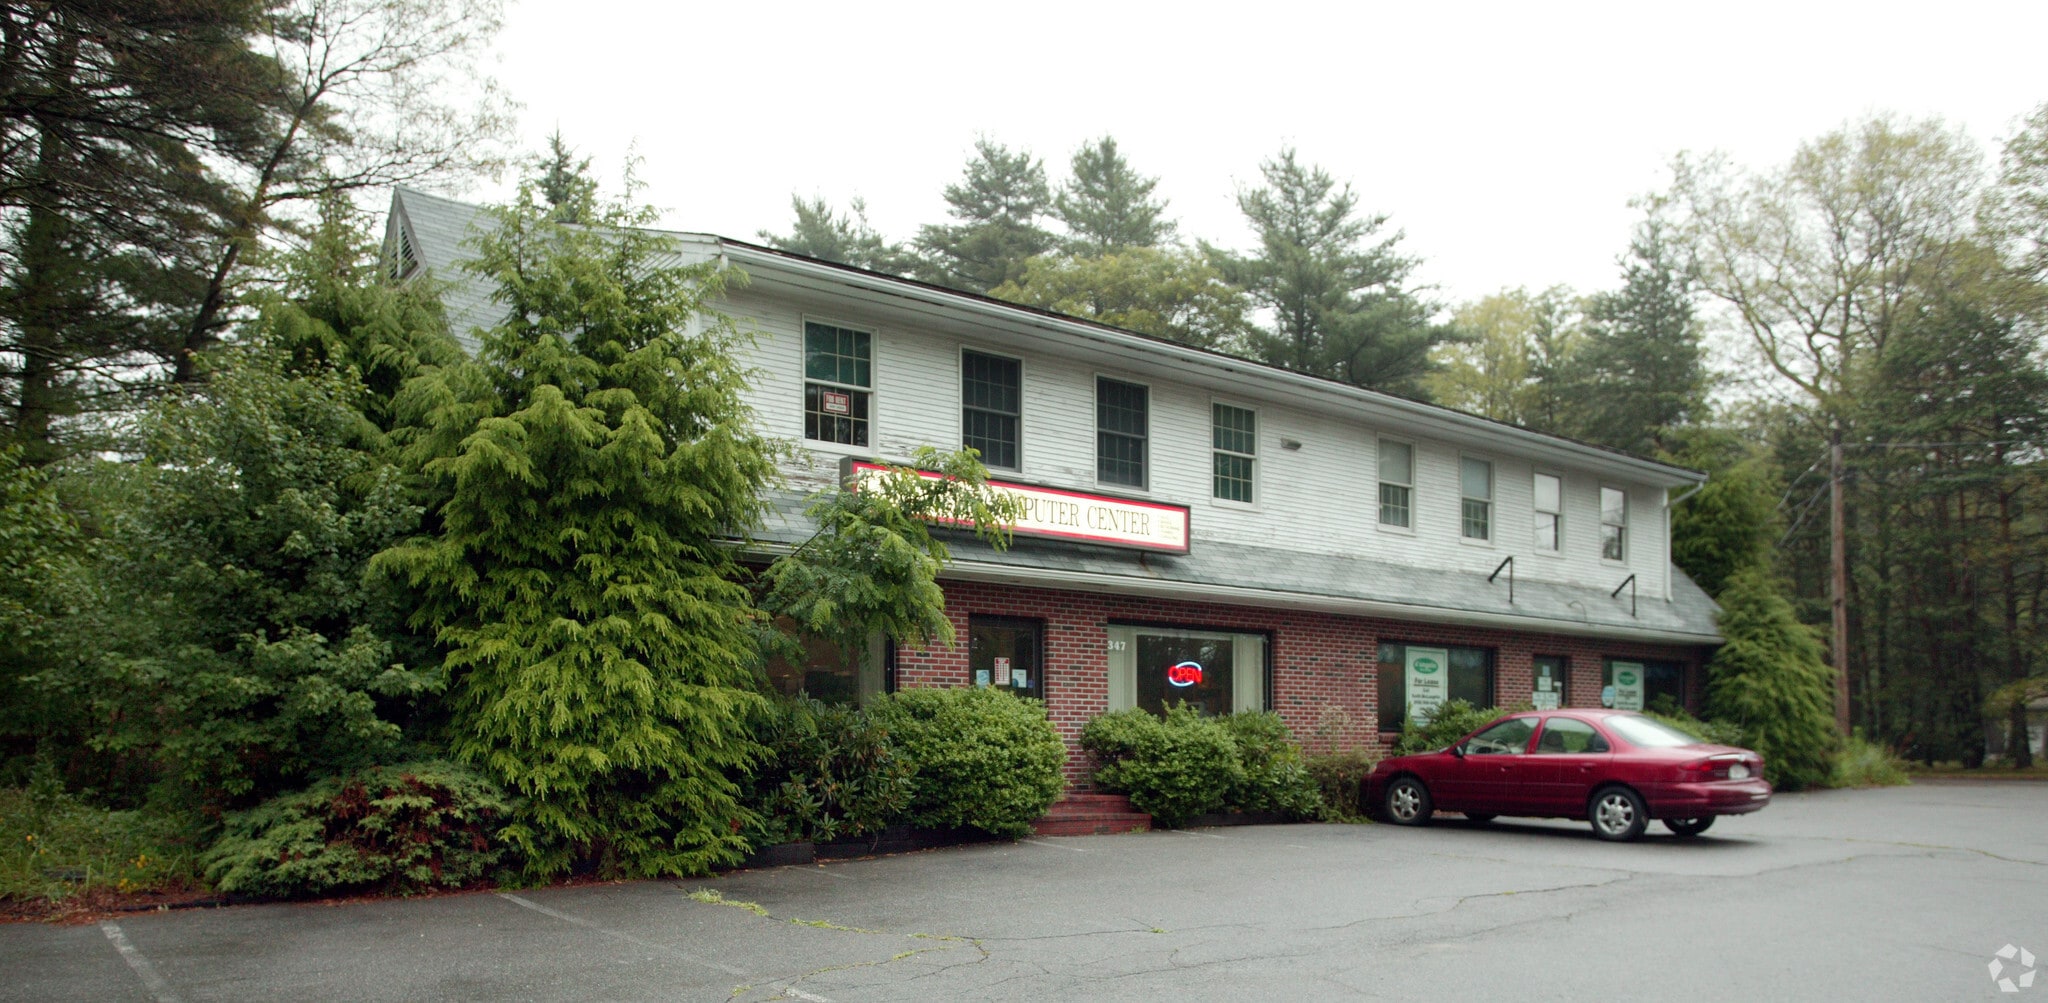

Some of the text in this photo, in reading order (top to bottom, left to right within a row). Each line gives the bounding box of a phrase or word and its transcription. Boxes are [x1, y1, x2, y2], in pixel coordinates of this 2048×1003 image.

[1087, 505, 1151, 536] CENTER
[1107, 640, 1126, 651] 347
[1168, 665, 1202, 684] OPEN
